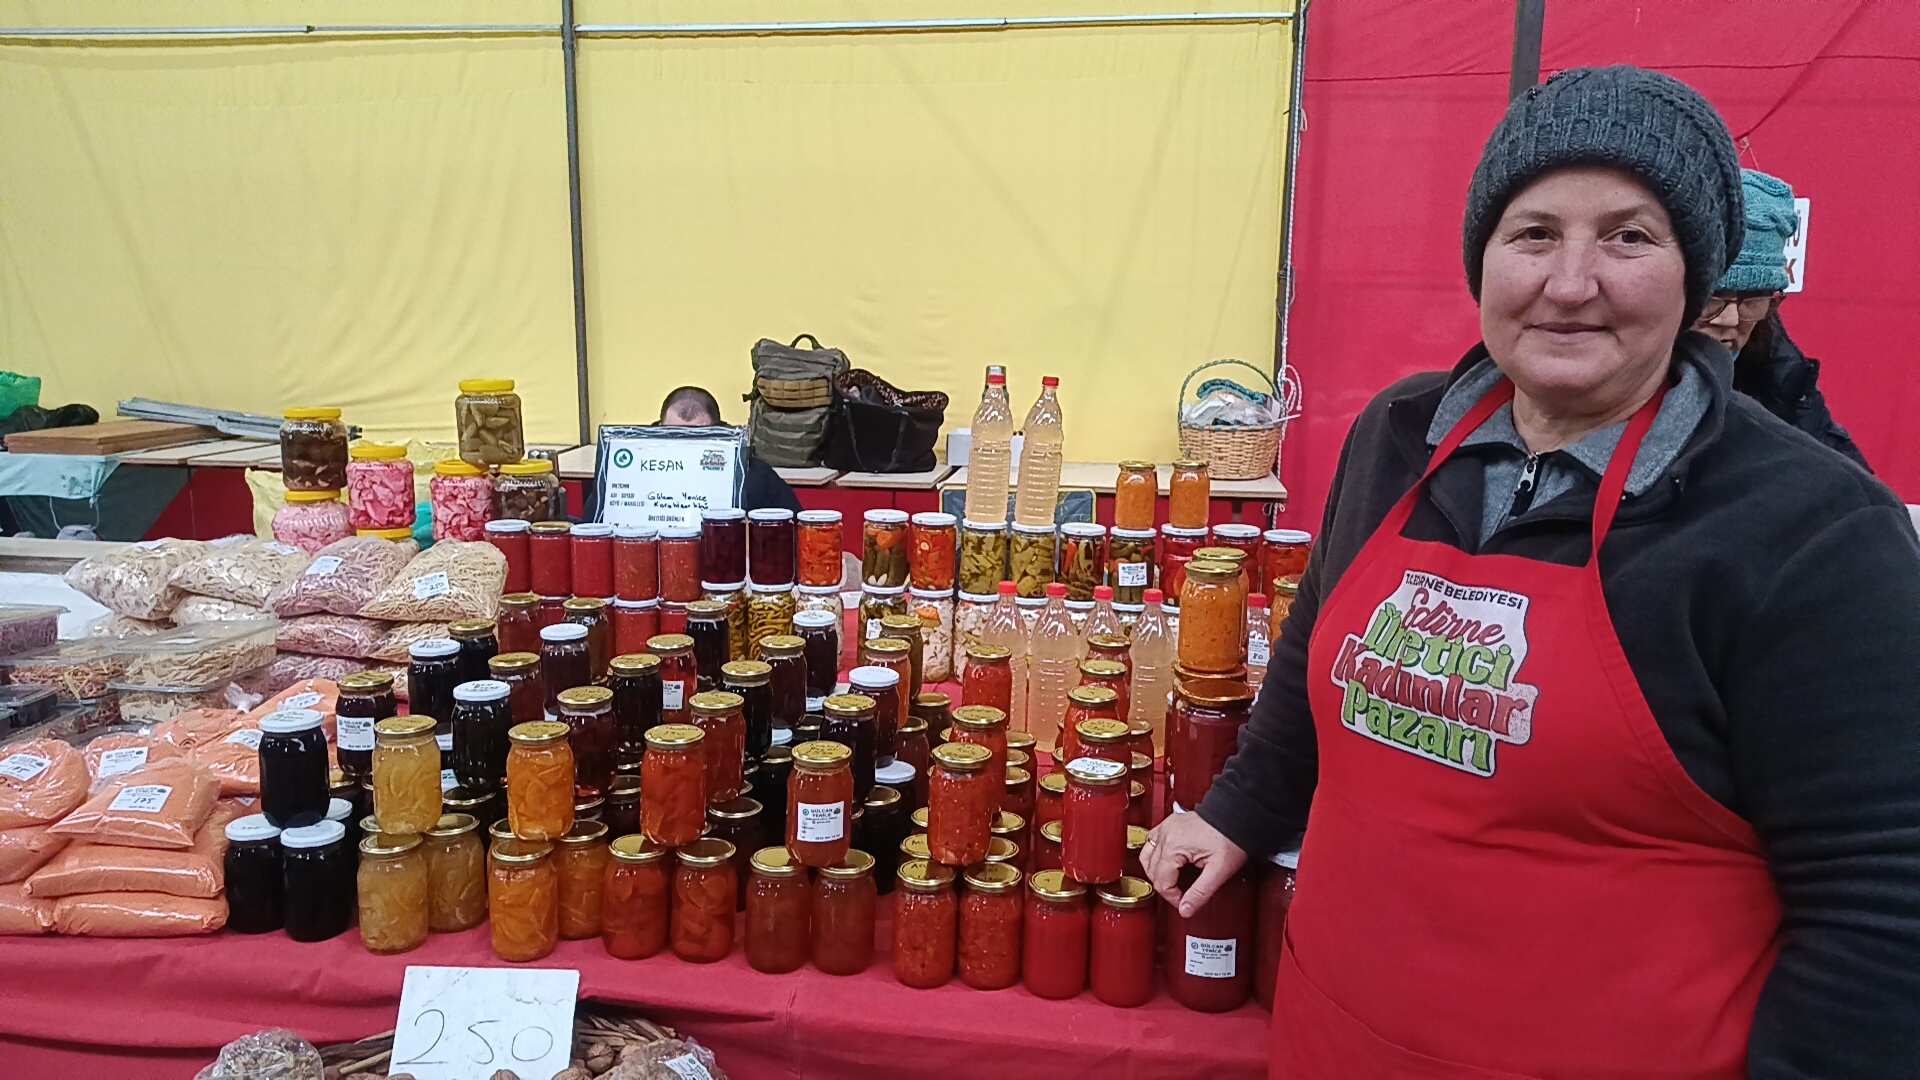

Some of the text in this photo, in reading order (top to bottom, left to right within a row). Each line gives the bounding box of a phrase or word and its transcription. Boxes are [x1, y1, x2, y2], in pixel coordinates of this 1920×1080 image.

[1401, 587, 1505, 646] Edirne
[1443, 583, 1524, 610] BELEDİYESİ
[1363, 602, 1515, 691] Üretici
[1333, 637, 1529, 735] Kadınlar
[1343, 678, 1491, 773] Pazarı
[396, 1008, 554, 1065] 250
